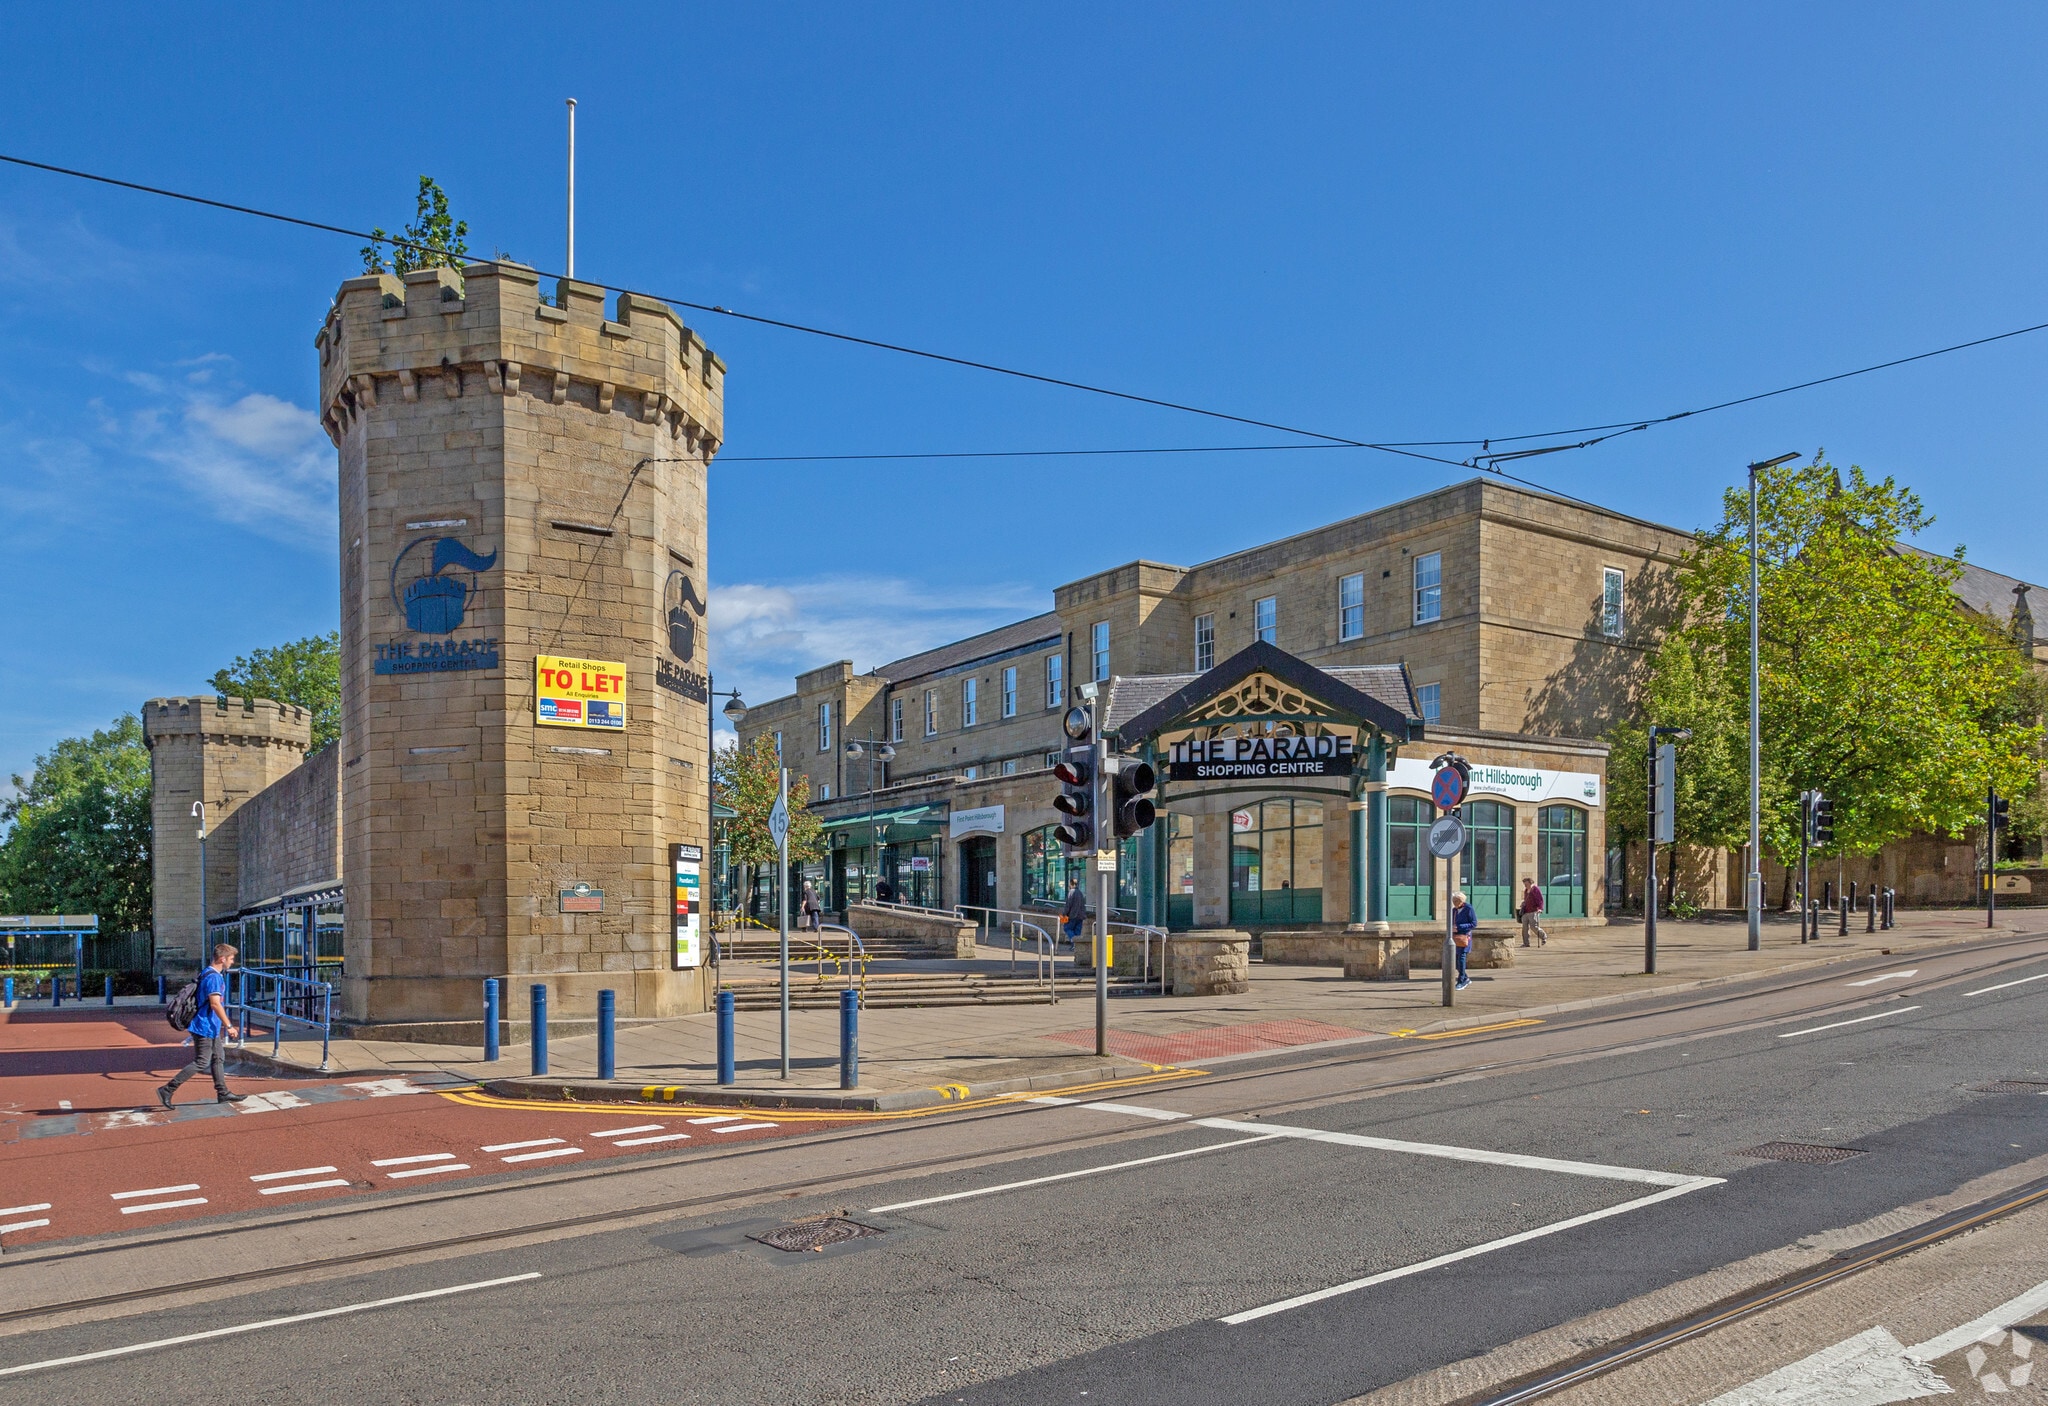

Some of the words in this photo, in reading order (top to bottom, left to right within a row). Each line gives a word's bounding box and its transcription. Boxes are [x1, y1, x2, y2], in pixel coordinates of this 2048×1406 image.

[375, 642, 412, 660] THE
[419, 637, 498, 660] PARADE
[392, 660, 438, 671] SHOPPING
[440, 658, 477, 669] CENTRE
[558, 660, 580, 669] Retail
[582, 662, 606, 672] Shops
[656, 656, 673, 675] THE
[675, 664, 707, 688] PARADE
[540, 667, 573, 690] TO
[581, 672, 623, 694] LET
[574, 691, 599, 699] Enquiries
[540, 704, 557, 712] smc
[1170, 740, 1225, 763] THE
[1235, 736, 1352, 761] PARADE
[1197, 763, 1266, 777] SHOPPING
[1269, 761, 1324, 774] CENTRE
[1486, 769, 1542, 791] Hillsborough
[772, 812, 786, 833] 15
[974, 812, 997, 821] Hillsborough
